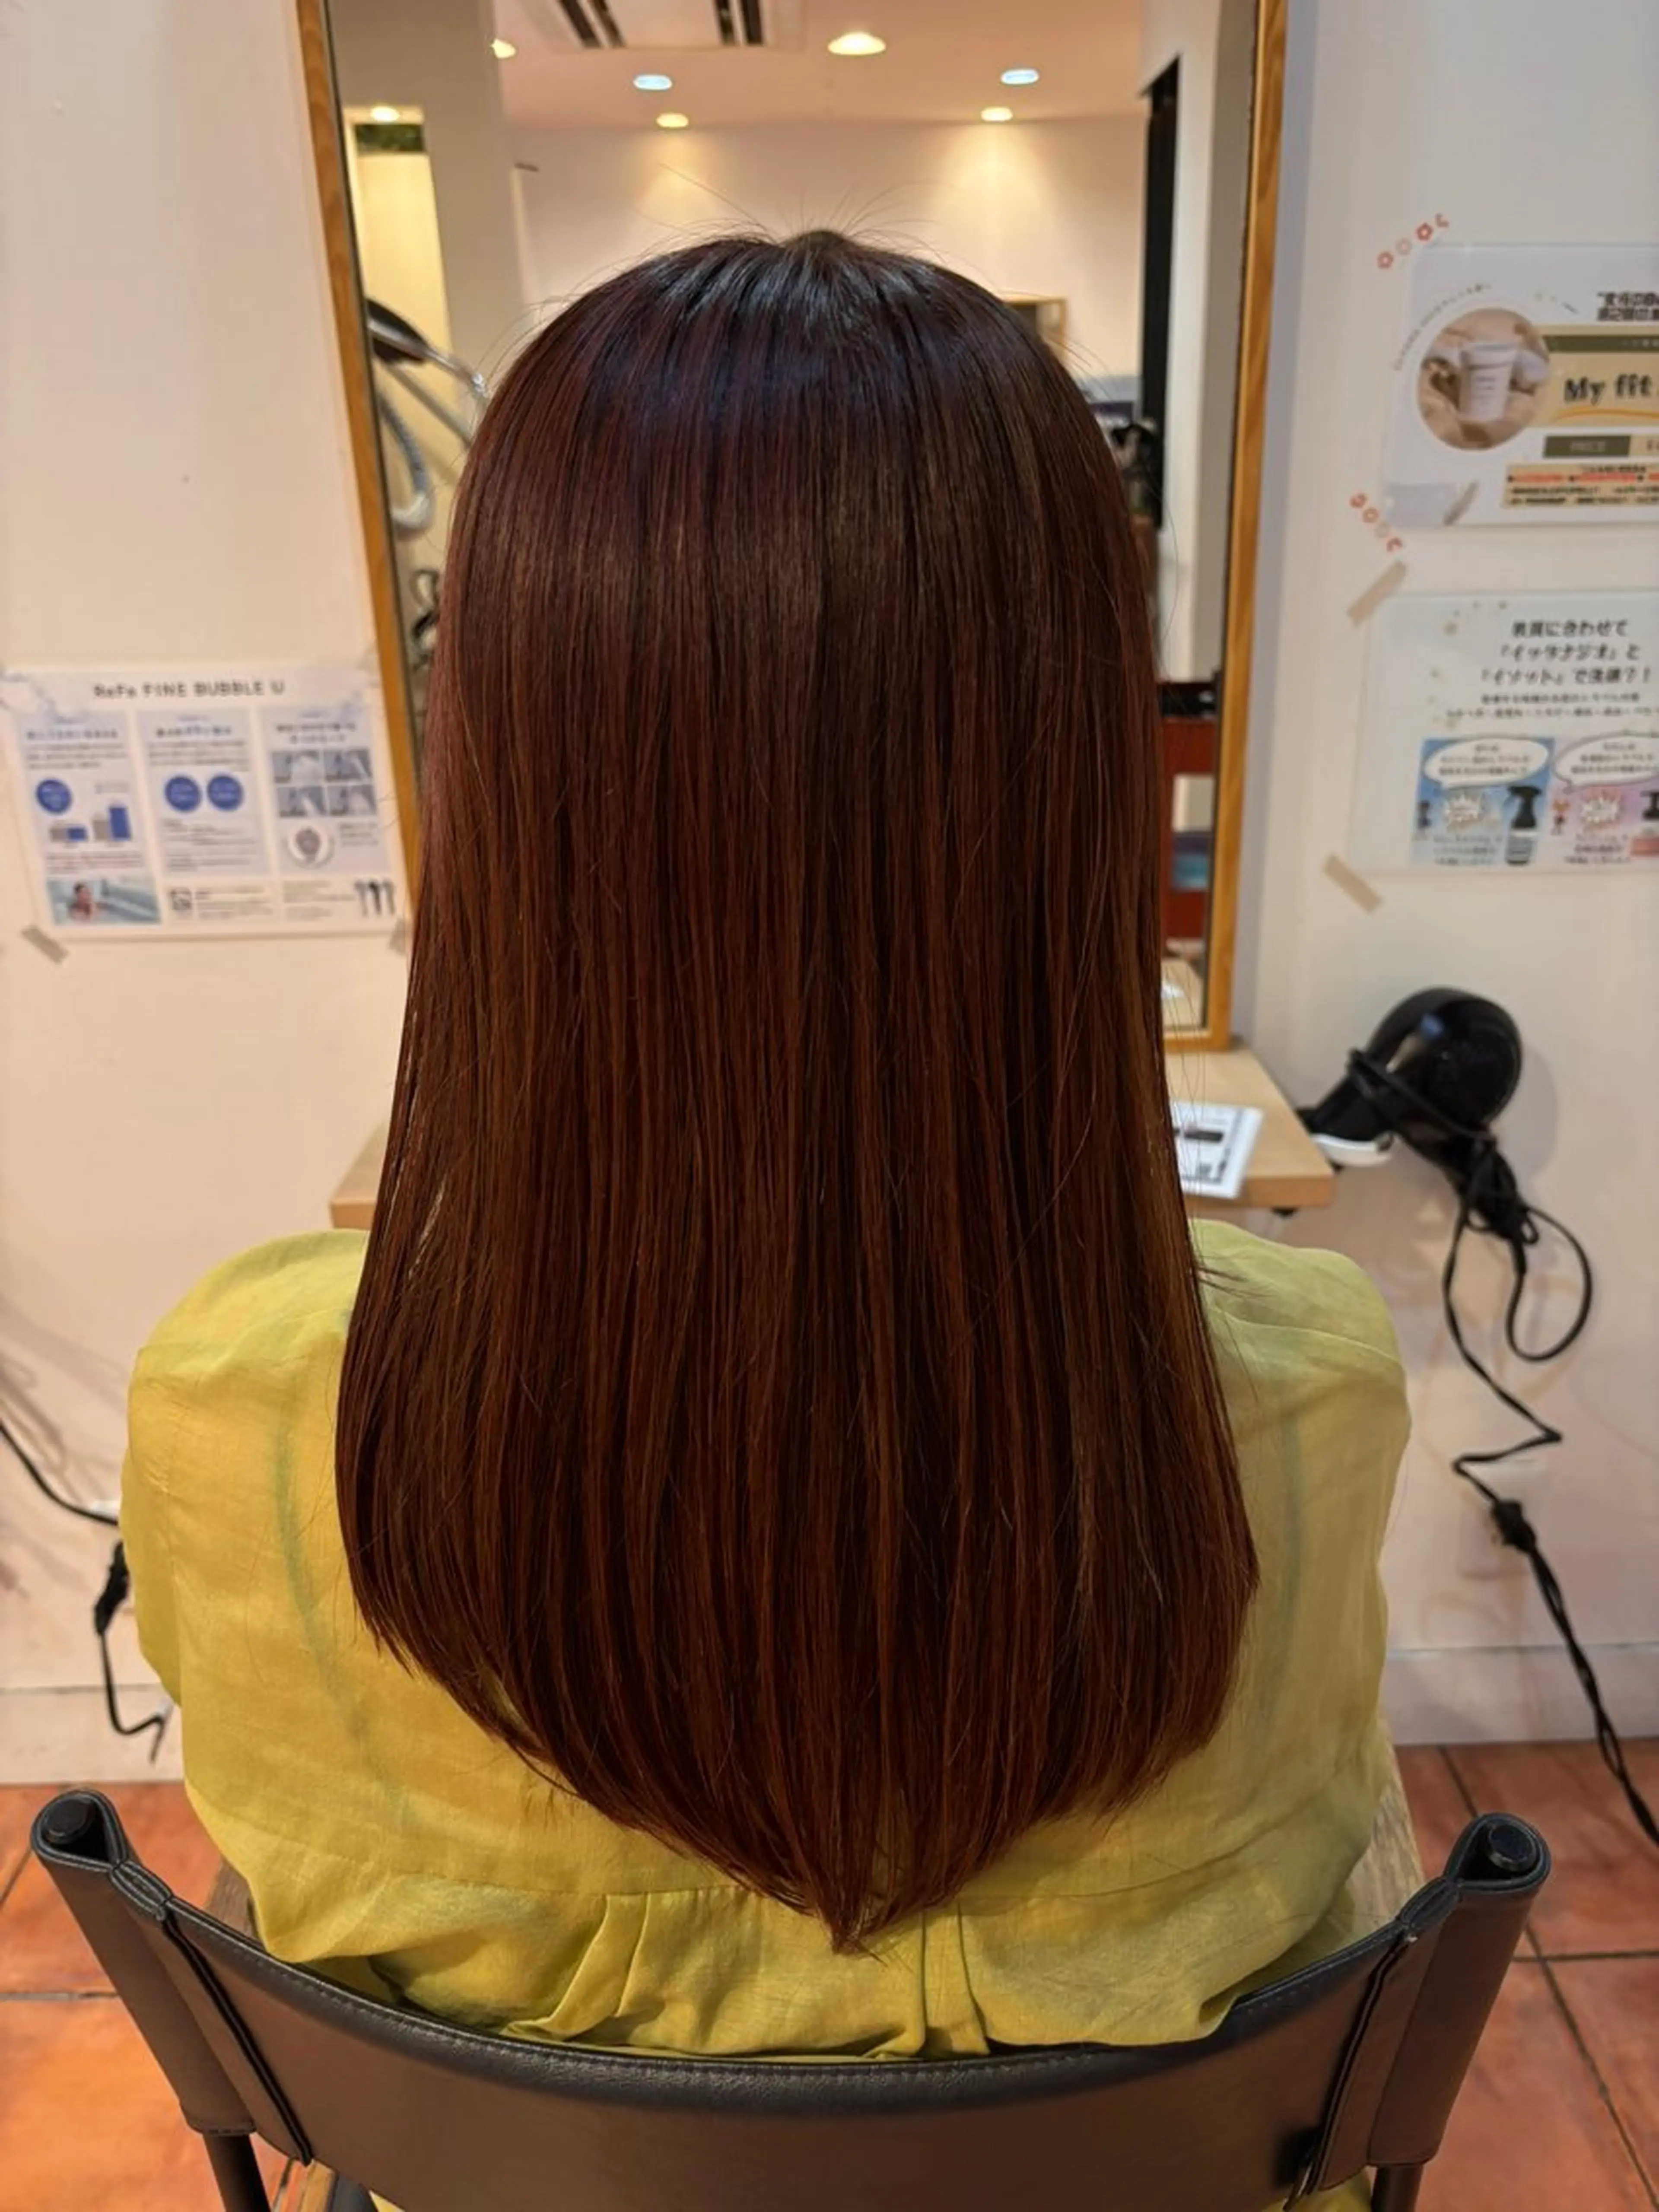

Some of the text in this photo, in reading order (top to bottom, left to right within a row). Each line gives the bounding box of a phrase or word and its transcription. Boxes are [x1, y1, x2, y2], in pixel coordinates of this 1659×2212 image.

[1564, 375, 1606, 405] My
[143, 682, 187, 698] FINE
[194, 681, 265, 697] BUBBLE
[270, 680, 286, 695] U
